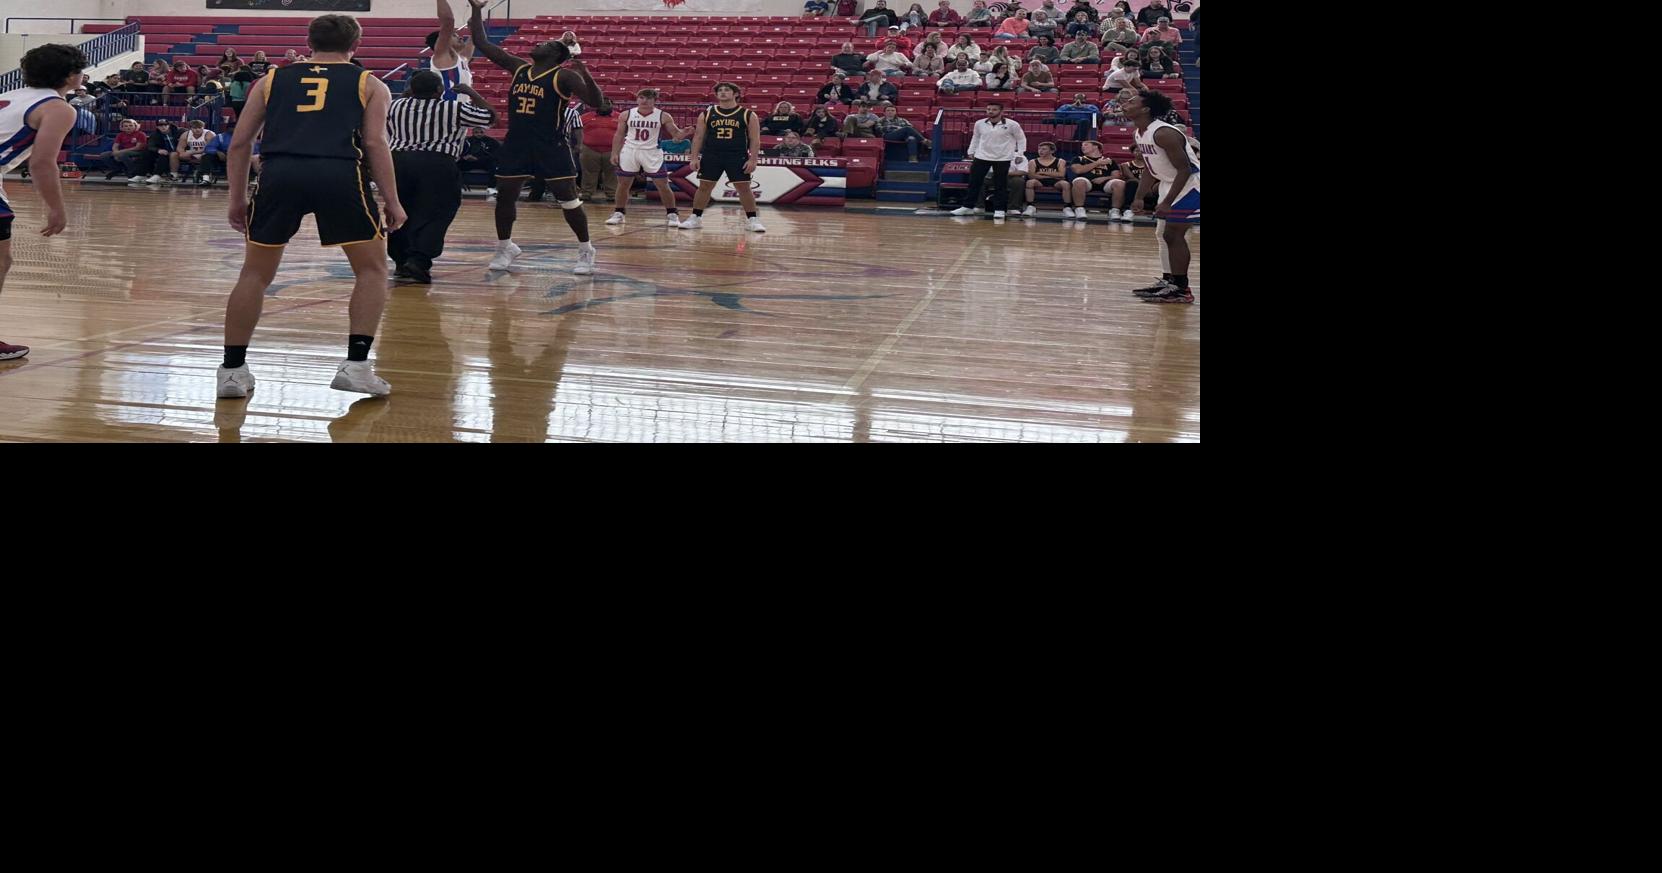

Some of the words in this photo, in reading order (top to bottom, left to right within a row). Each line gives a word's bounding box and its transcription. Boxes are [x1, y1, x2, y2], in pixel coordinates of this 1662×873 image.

[296, 77, 329, 113] 3
[512, 83, 545, 99] CAYUGA
[516, 97, 536, 114] 32
[629, 120, 658, 129] ELKHART
[711, 119, 741, 129] CAYUGA
[634, 128, 649, 141] 10
[716, 127, 734, 139] 23
[664, 154, 693, 162] OME
[804, 158, 838, 167] ELKS
[722, 190, 762, 199] ELS
